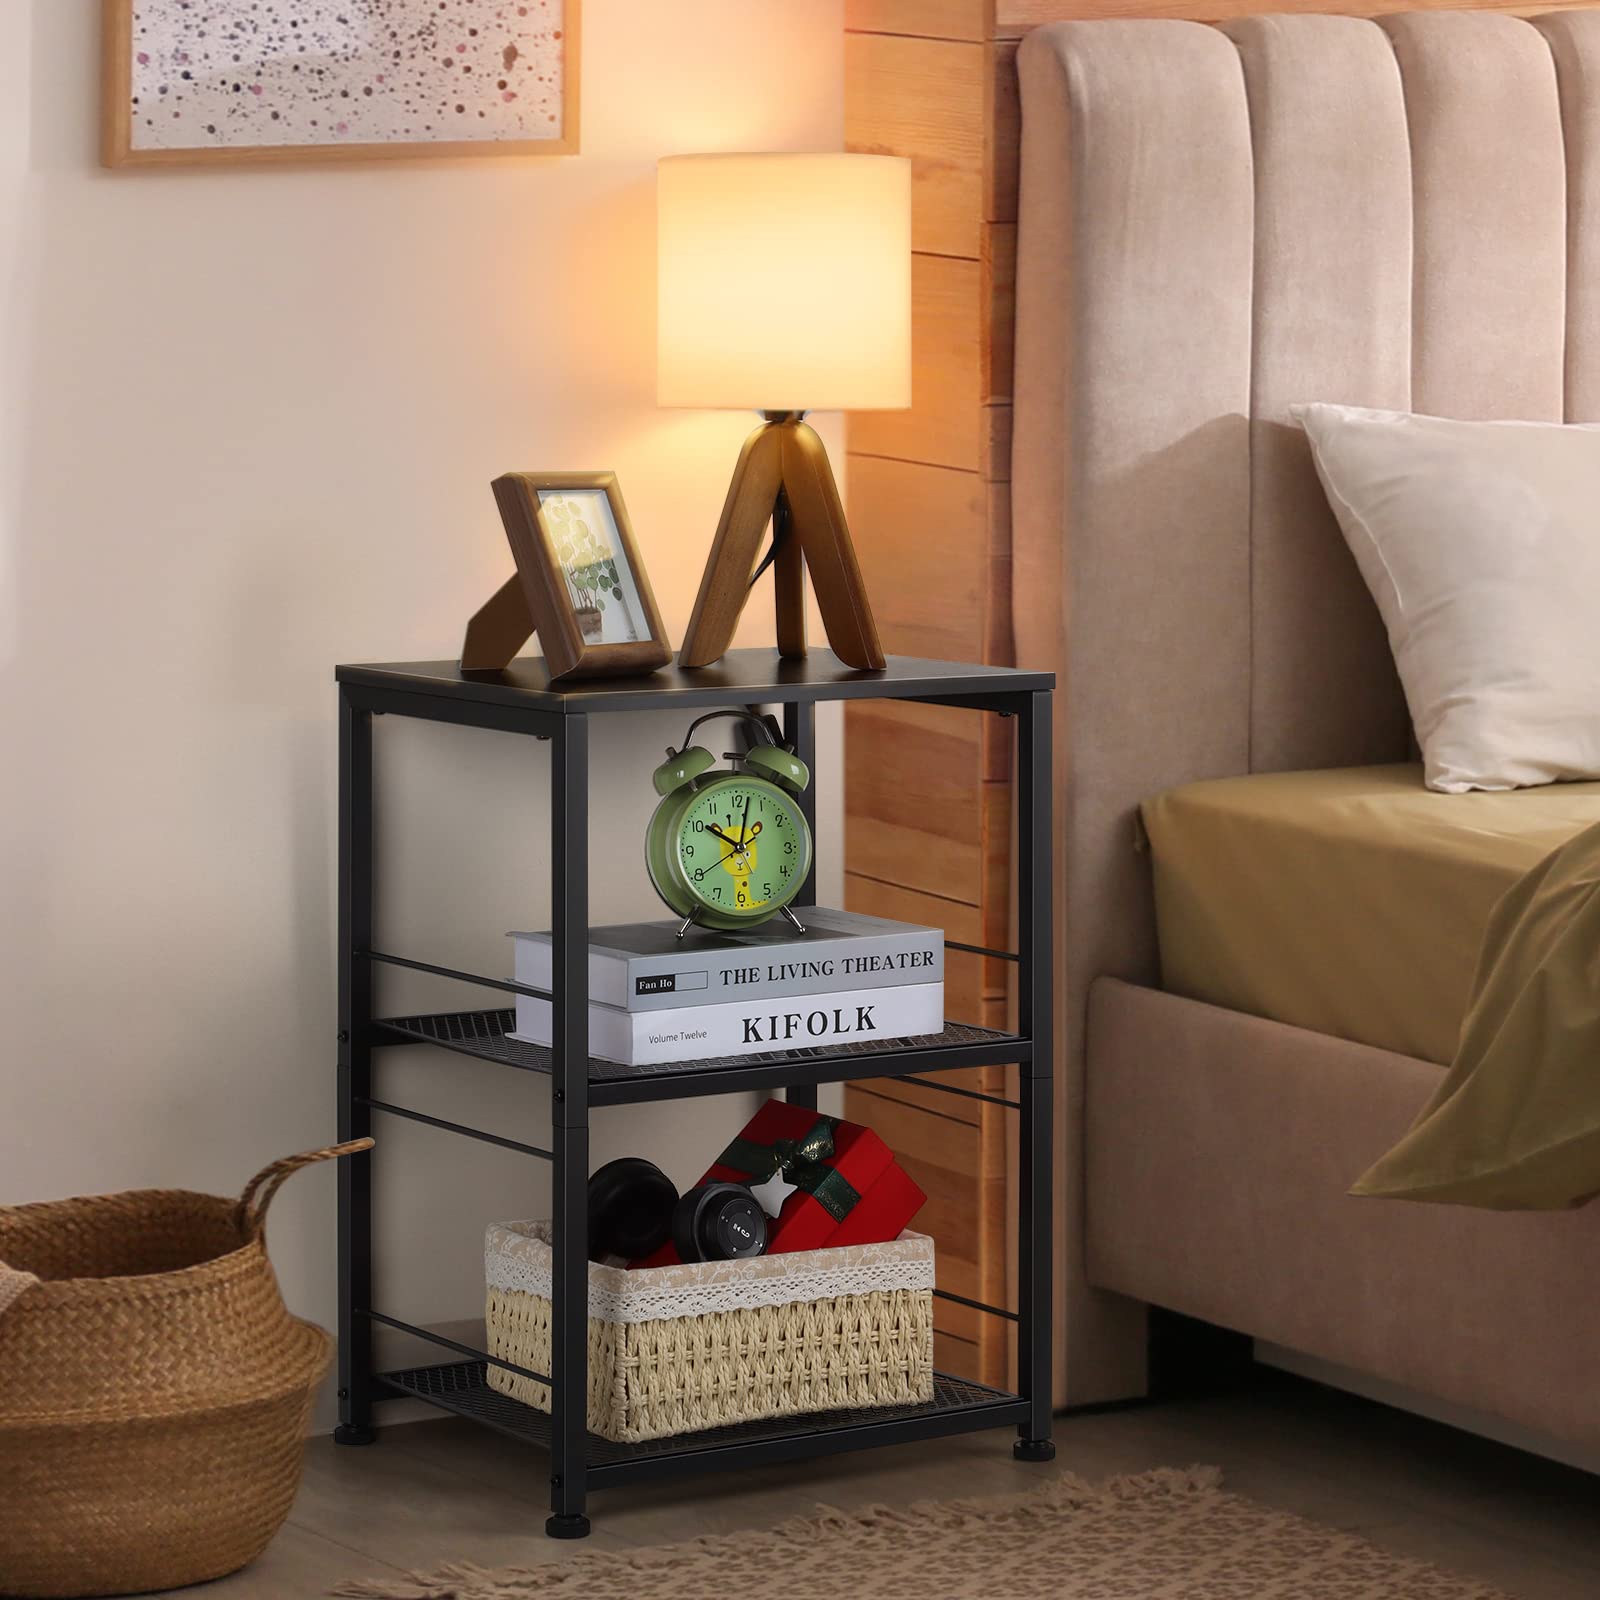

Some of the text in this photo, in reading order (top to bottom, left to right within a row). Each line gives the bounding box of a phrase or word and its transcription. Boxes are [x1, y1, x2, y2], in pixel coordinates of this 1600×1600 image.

[731, 795, 743, 808] 12
[759, 800, 763, 812] 1
[709, 803, 717, 815] 11
[692, 820, 704, 833] 10
[775, 815, 783, 827] 2
[685, 845, 694, 858] 9
[784, 842, 793, 854] 3
[694, 868, 704, 882] 8
[780, 865, 788, 877] 4
[713, 887, 722, 899] 7
[763, 883, 771, 896] 5
[737, 891, 746, 903] 6
[719, 950, 935, 986] THE LIVING THEATER
[639, 978, 673, 990] Fan Ho
[741, 1005, 876, 1043] KIFOLK
[649, 1029, 708, 1044] Volume Twelve
